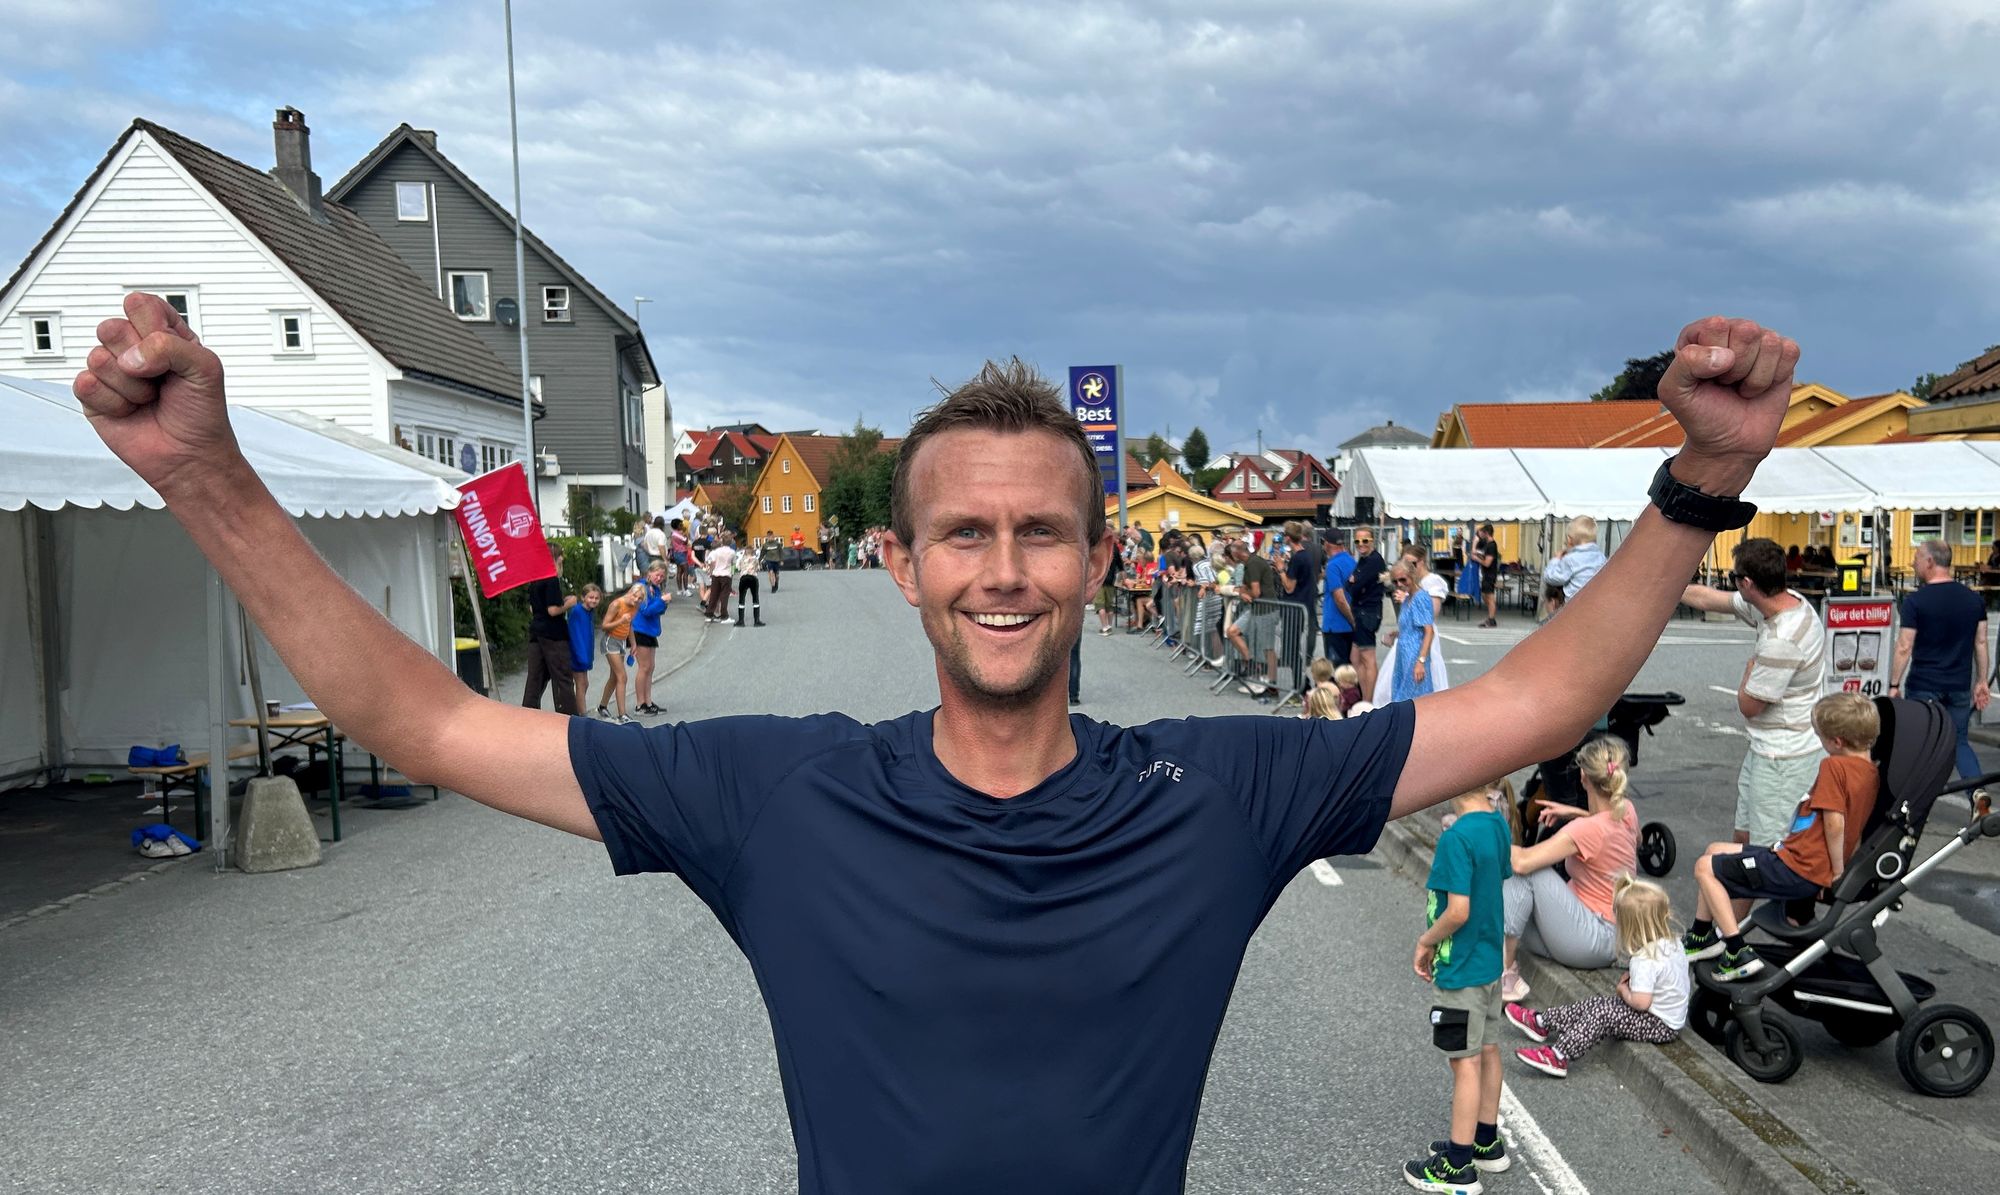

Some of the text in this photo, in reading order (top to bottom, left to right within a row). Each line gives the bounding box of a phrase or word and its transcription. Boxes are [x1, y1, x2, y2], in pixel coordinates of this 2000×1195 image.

[1076, 406, 1112, 421] Best
[462, 490, 501, 559] FINNØY
[487, 560, 507, 583] IL
[1849, 608, 1864, 621] det
[1861, 679, 1881, 696] 40
